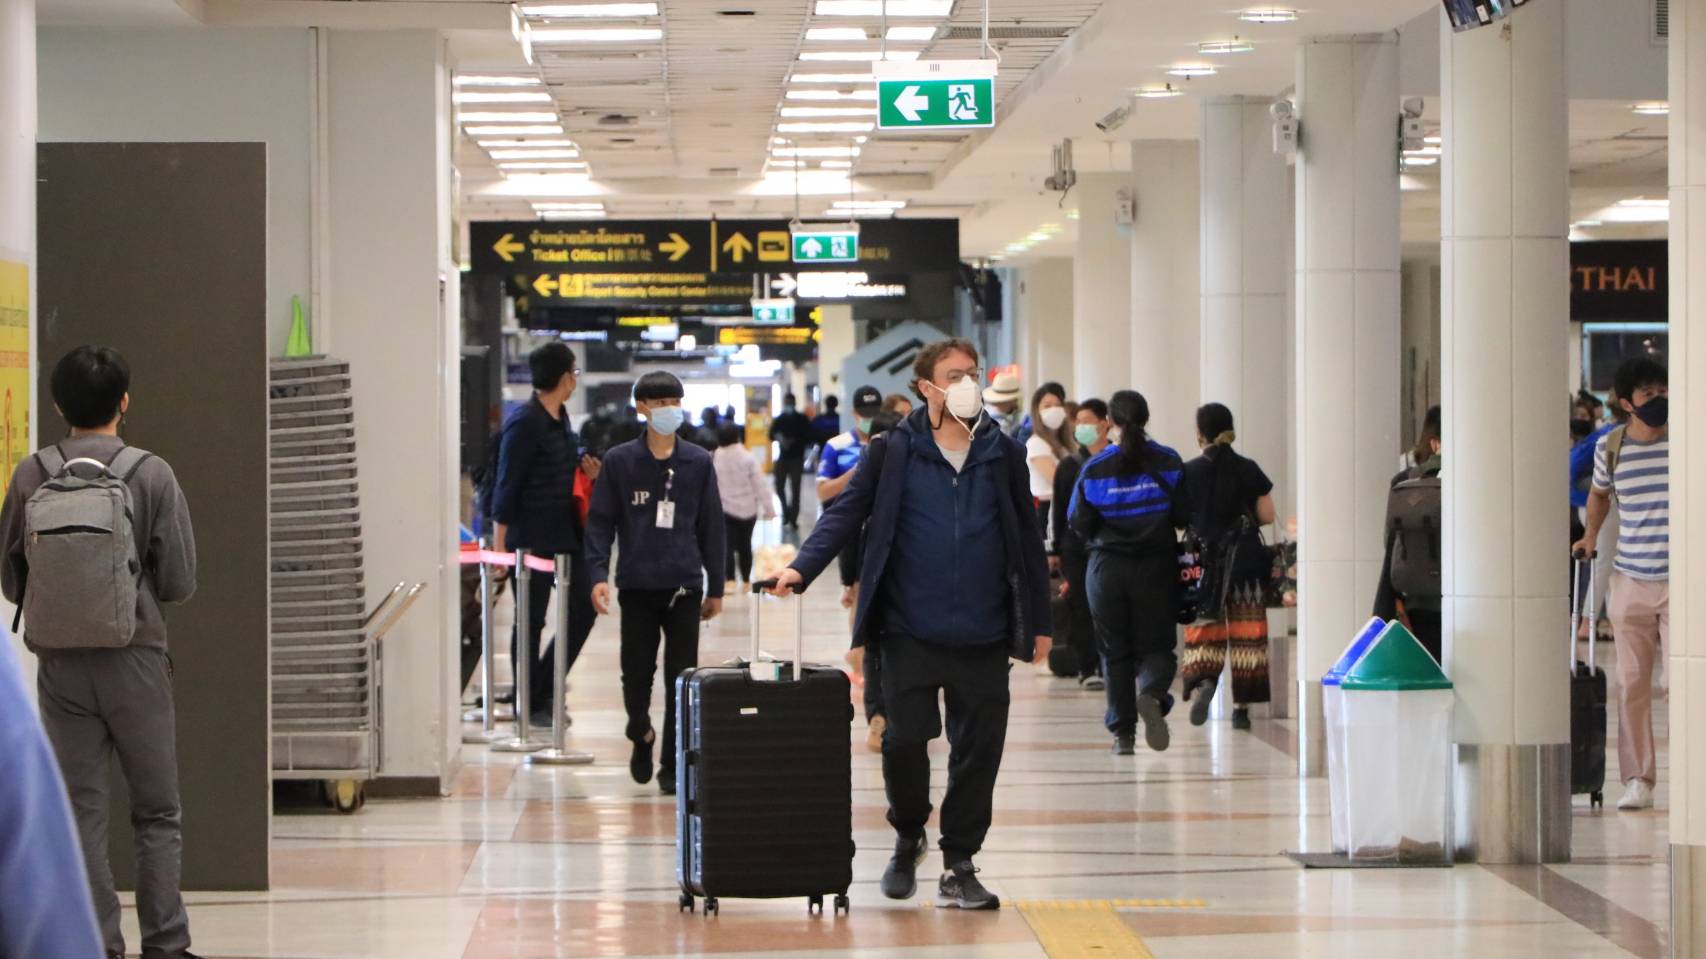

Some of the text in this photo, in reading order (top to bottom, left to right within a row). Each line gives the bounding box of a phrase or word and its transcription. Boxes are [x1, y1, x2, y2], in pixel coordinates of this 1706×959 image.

[532, 248, 569, 262] Ticket
[570, 248, 606, 262] Office
[1576, 266, 1655, 290] THAI
[631, 491, 650, 505] JP
